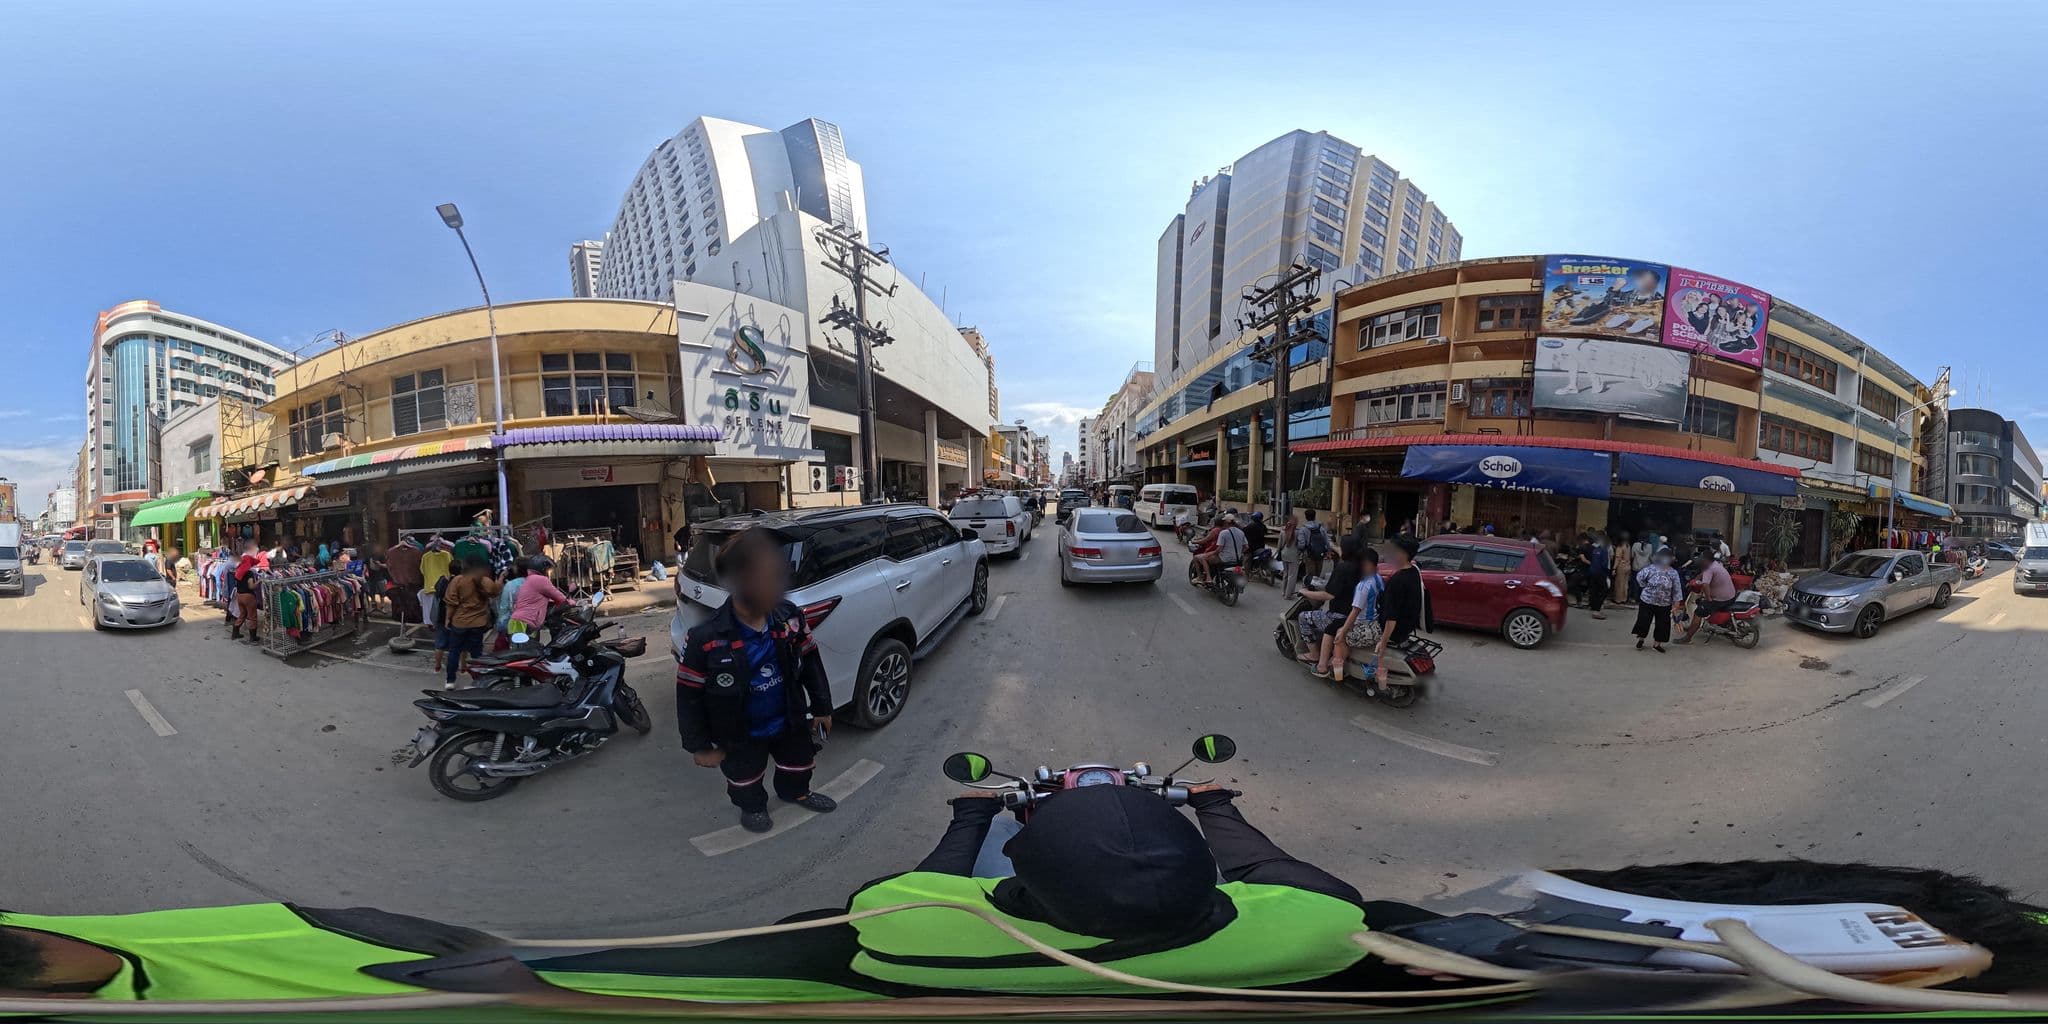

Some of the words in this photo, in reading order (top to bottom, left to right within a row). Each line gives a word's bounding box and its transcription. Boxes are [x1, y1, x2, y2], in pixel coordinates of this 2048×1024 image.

[1561, 264, 1629, 275] Breaker
[1672, 322, 1696, 331] POP
[1671, 329, 1708, 342] SCENE
[726, 415, 783, 430] SERENE
[1482, 459, 1518, 473] Scholl
[1702, 479, 1732, 492] Scholl
